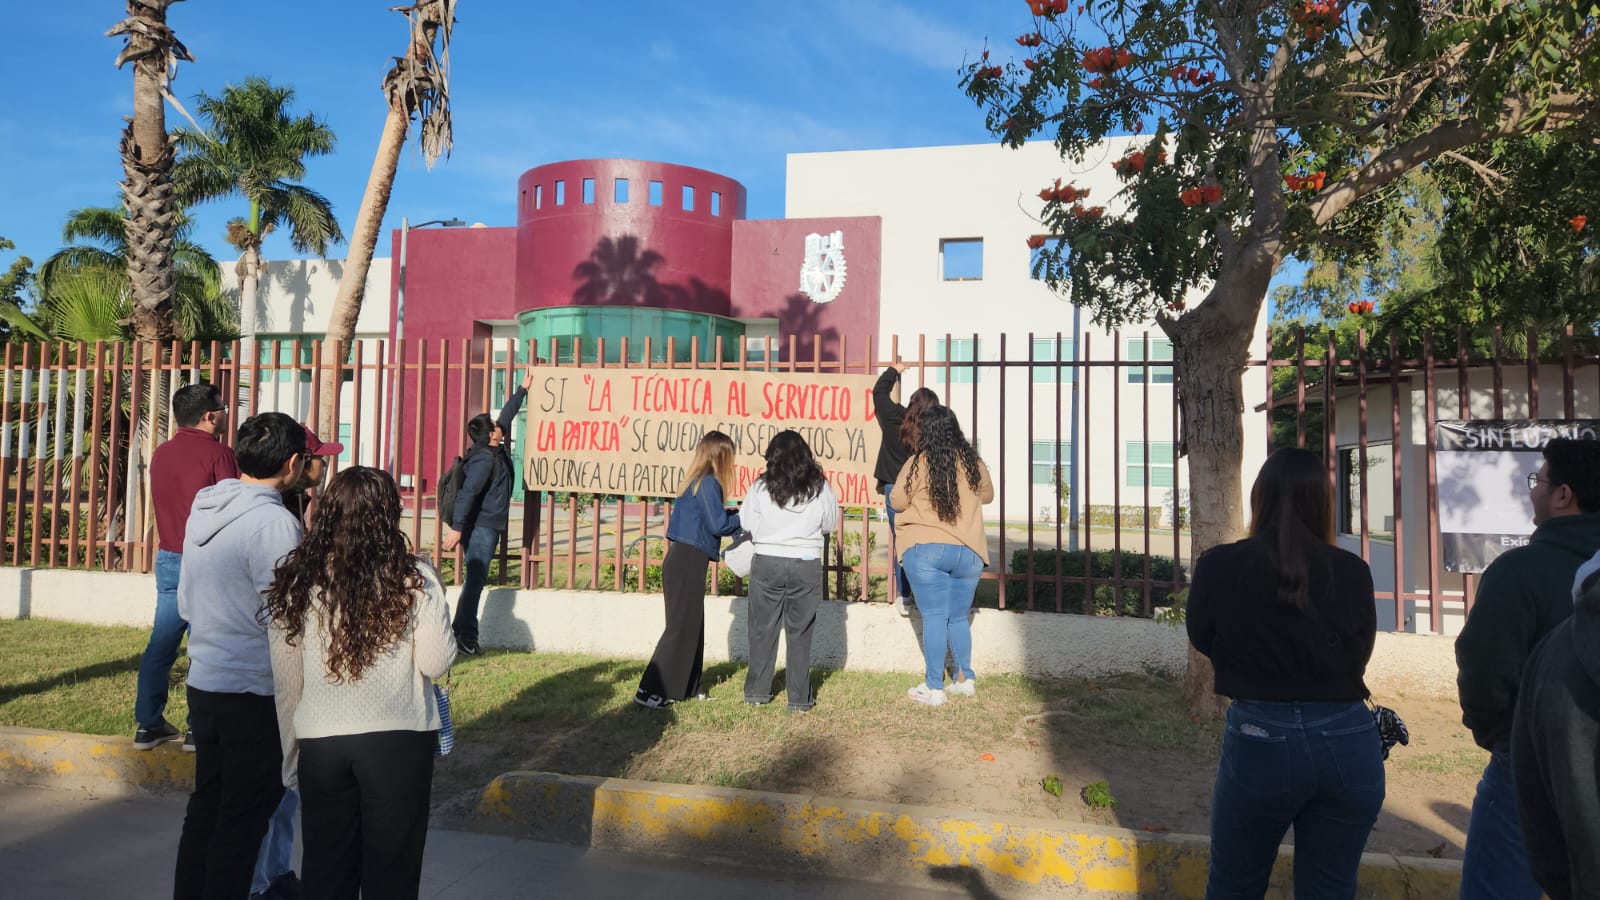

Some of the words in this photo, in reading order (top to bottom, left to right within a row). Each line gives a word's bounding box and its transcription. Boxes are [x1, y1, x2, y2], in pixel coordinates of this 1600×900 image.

[540, 376, 568, 413] SI
[631, 372, 713, 415] TÉCNICA
[727, 380, 750, 417] AL
[761, 381, 851, 421] SERVICIO
[537, 419, 556, 452] LA
[631, 418, 652, 453] SE
[716, 422, 744, 455] IN
[845, 427, 867, 463] YA
[1465, 427, 1504, 449] SIN
[529, 457, 549, 486] NO
[589, 461, 602, 489] A
[608, 461, 627, 492] LA
